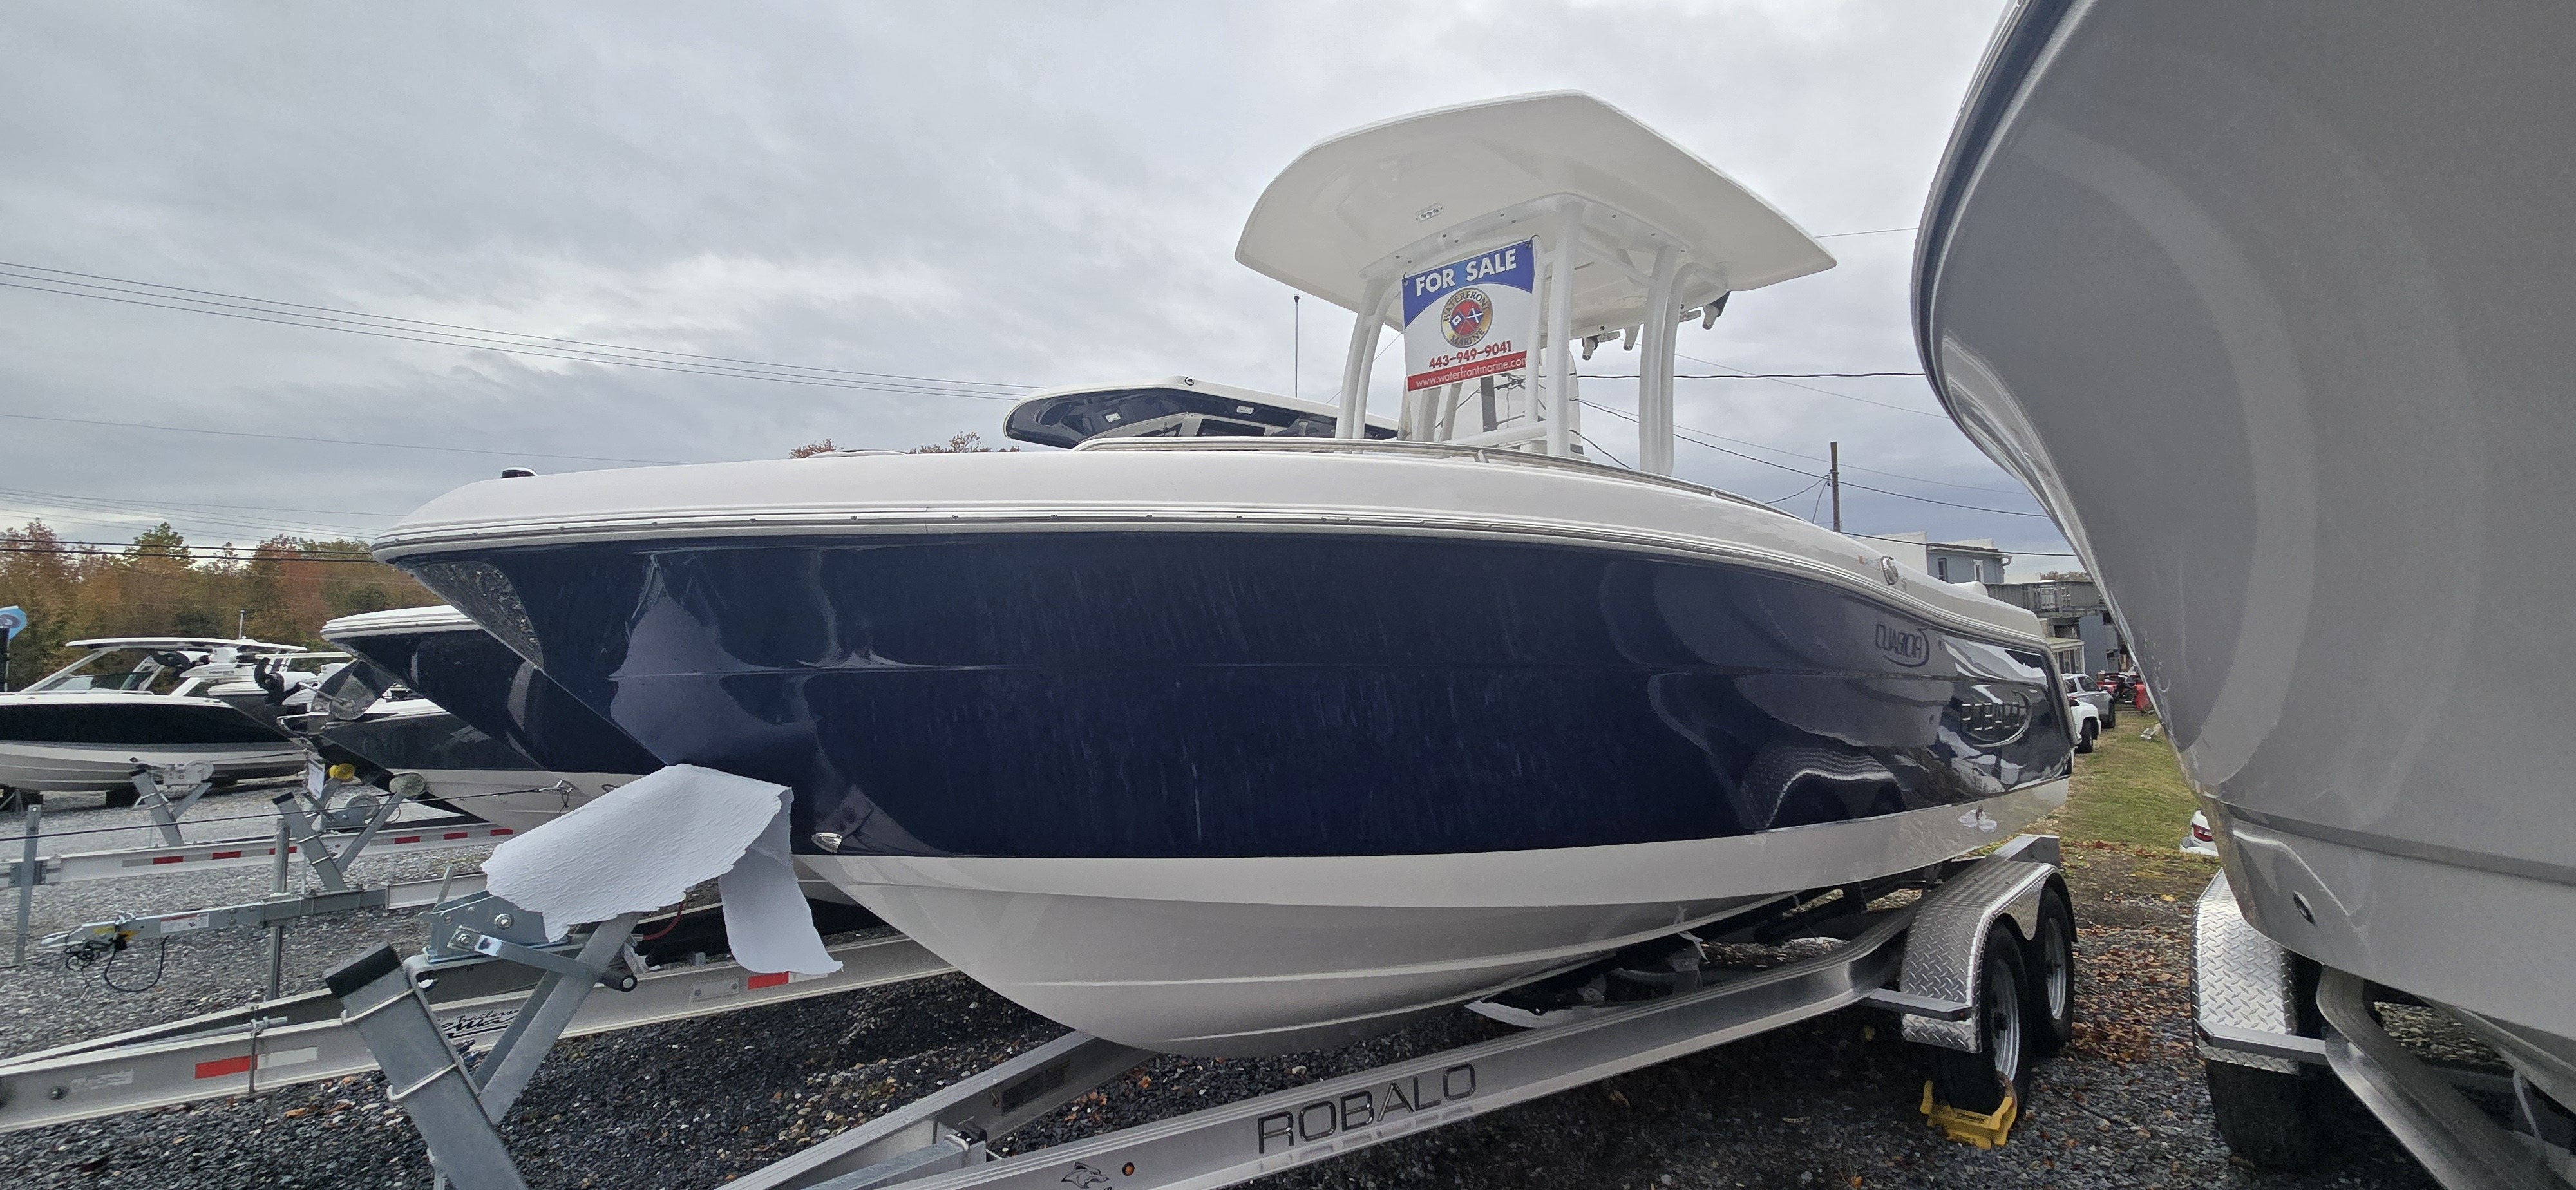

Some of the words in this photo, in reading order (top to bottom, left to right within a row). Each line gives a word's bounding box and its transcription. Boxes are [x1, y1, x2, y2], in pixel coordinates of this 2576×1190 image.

[1416, 269, 1455, 297] FOR
[1466, 249, 1517, 281] SALE
[1443, 290, 1490, 323] WATERFRONT
[1449, 328, 1486, 346] MARINE
[1428, 339, 1512, 369] 443-949-9041
[1257, 1063, 1476, 1154] ROBALO
